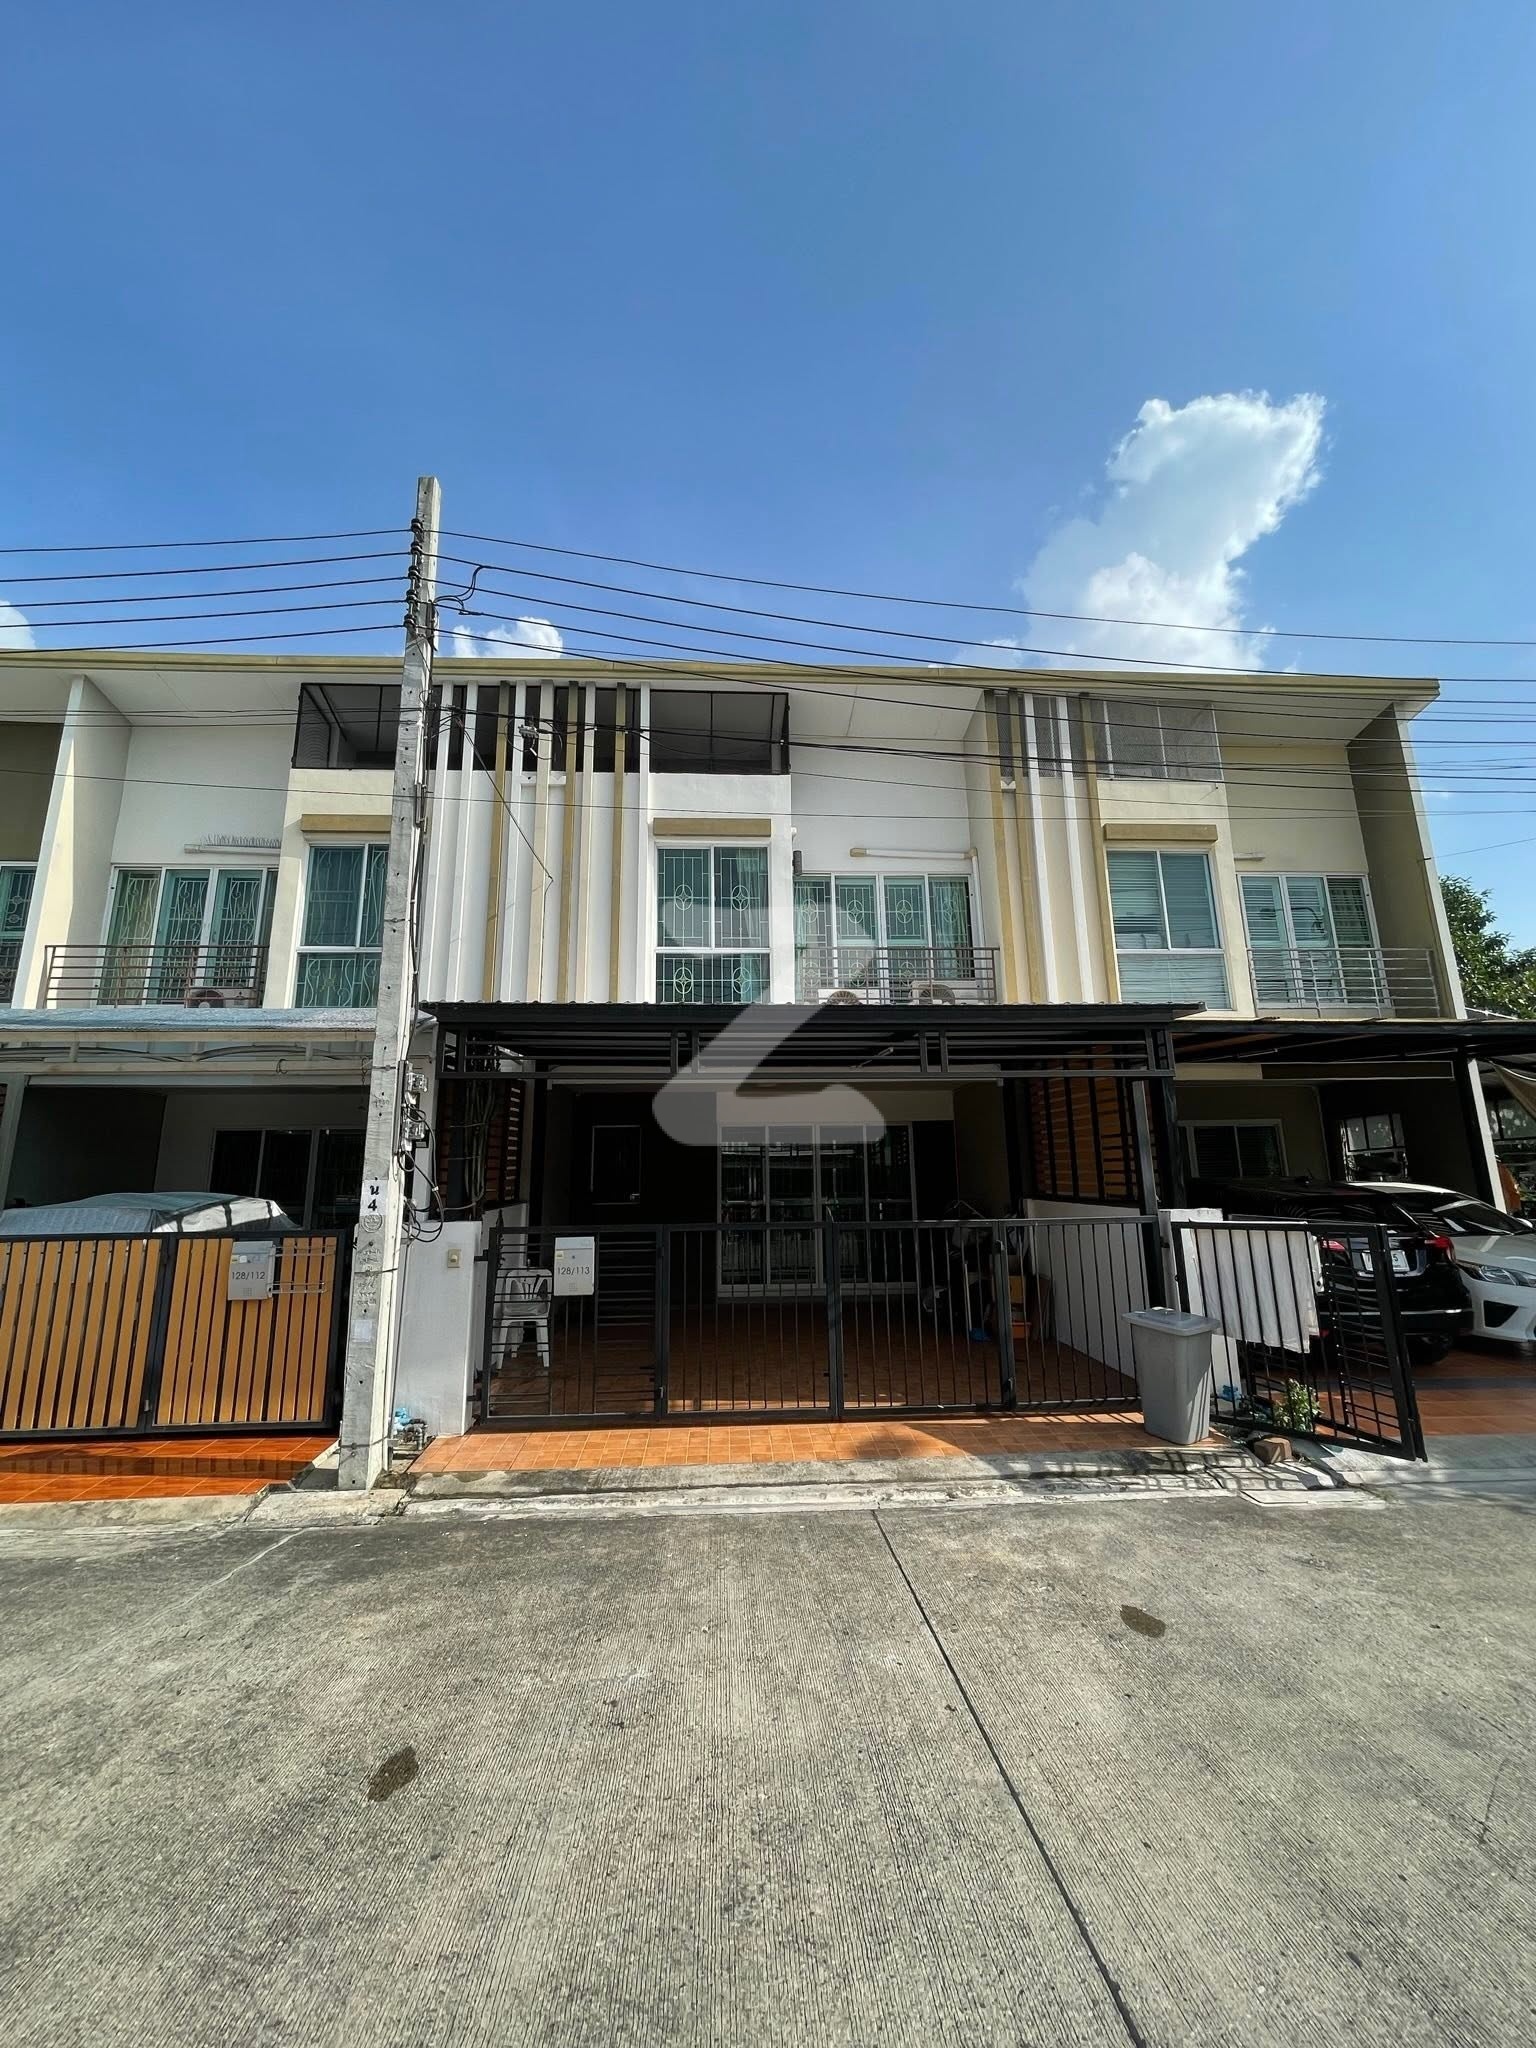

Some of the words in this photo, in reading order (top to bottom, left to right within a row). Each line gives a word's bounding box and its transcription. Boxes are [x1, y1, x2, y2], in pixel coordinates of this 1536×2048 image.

[367, 1199, 378, 1212] 4
[232, 1271, 266, 1280] 128/112
[558, 1266, 590, 1276] 128/113
